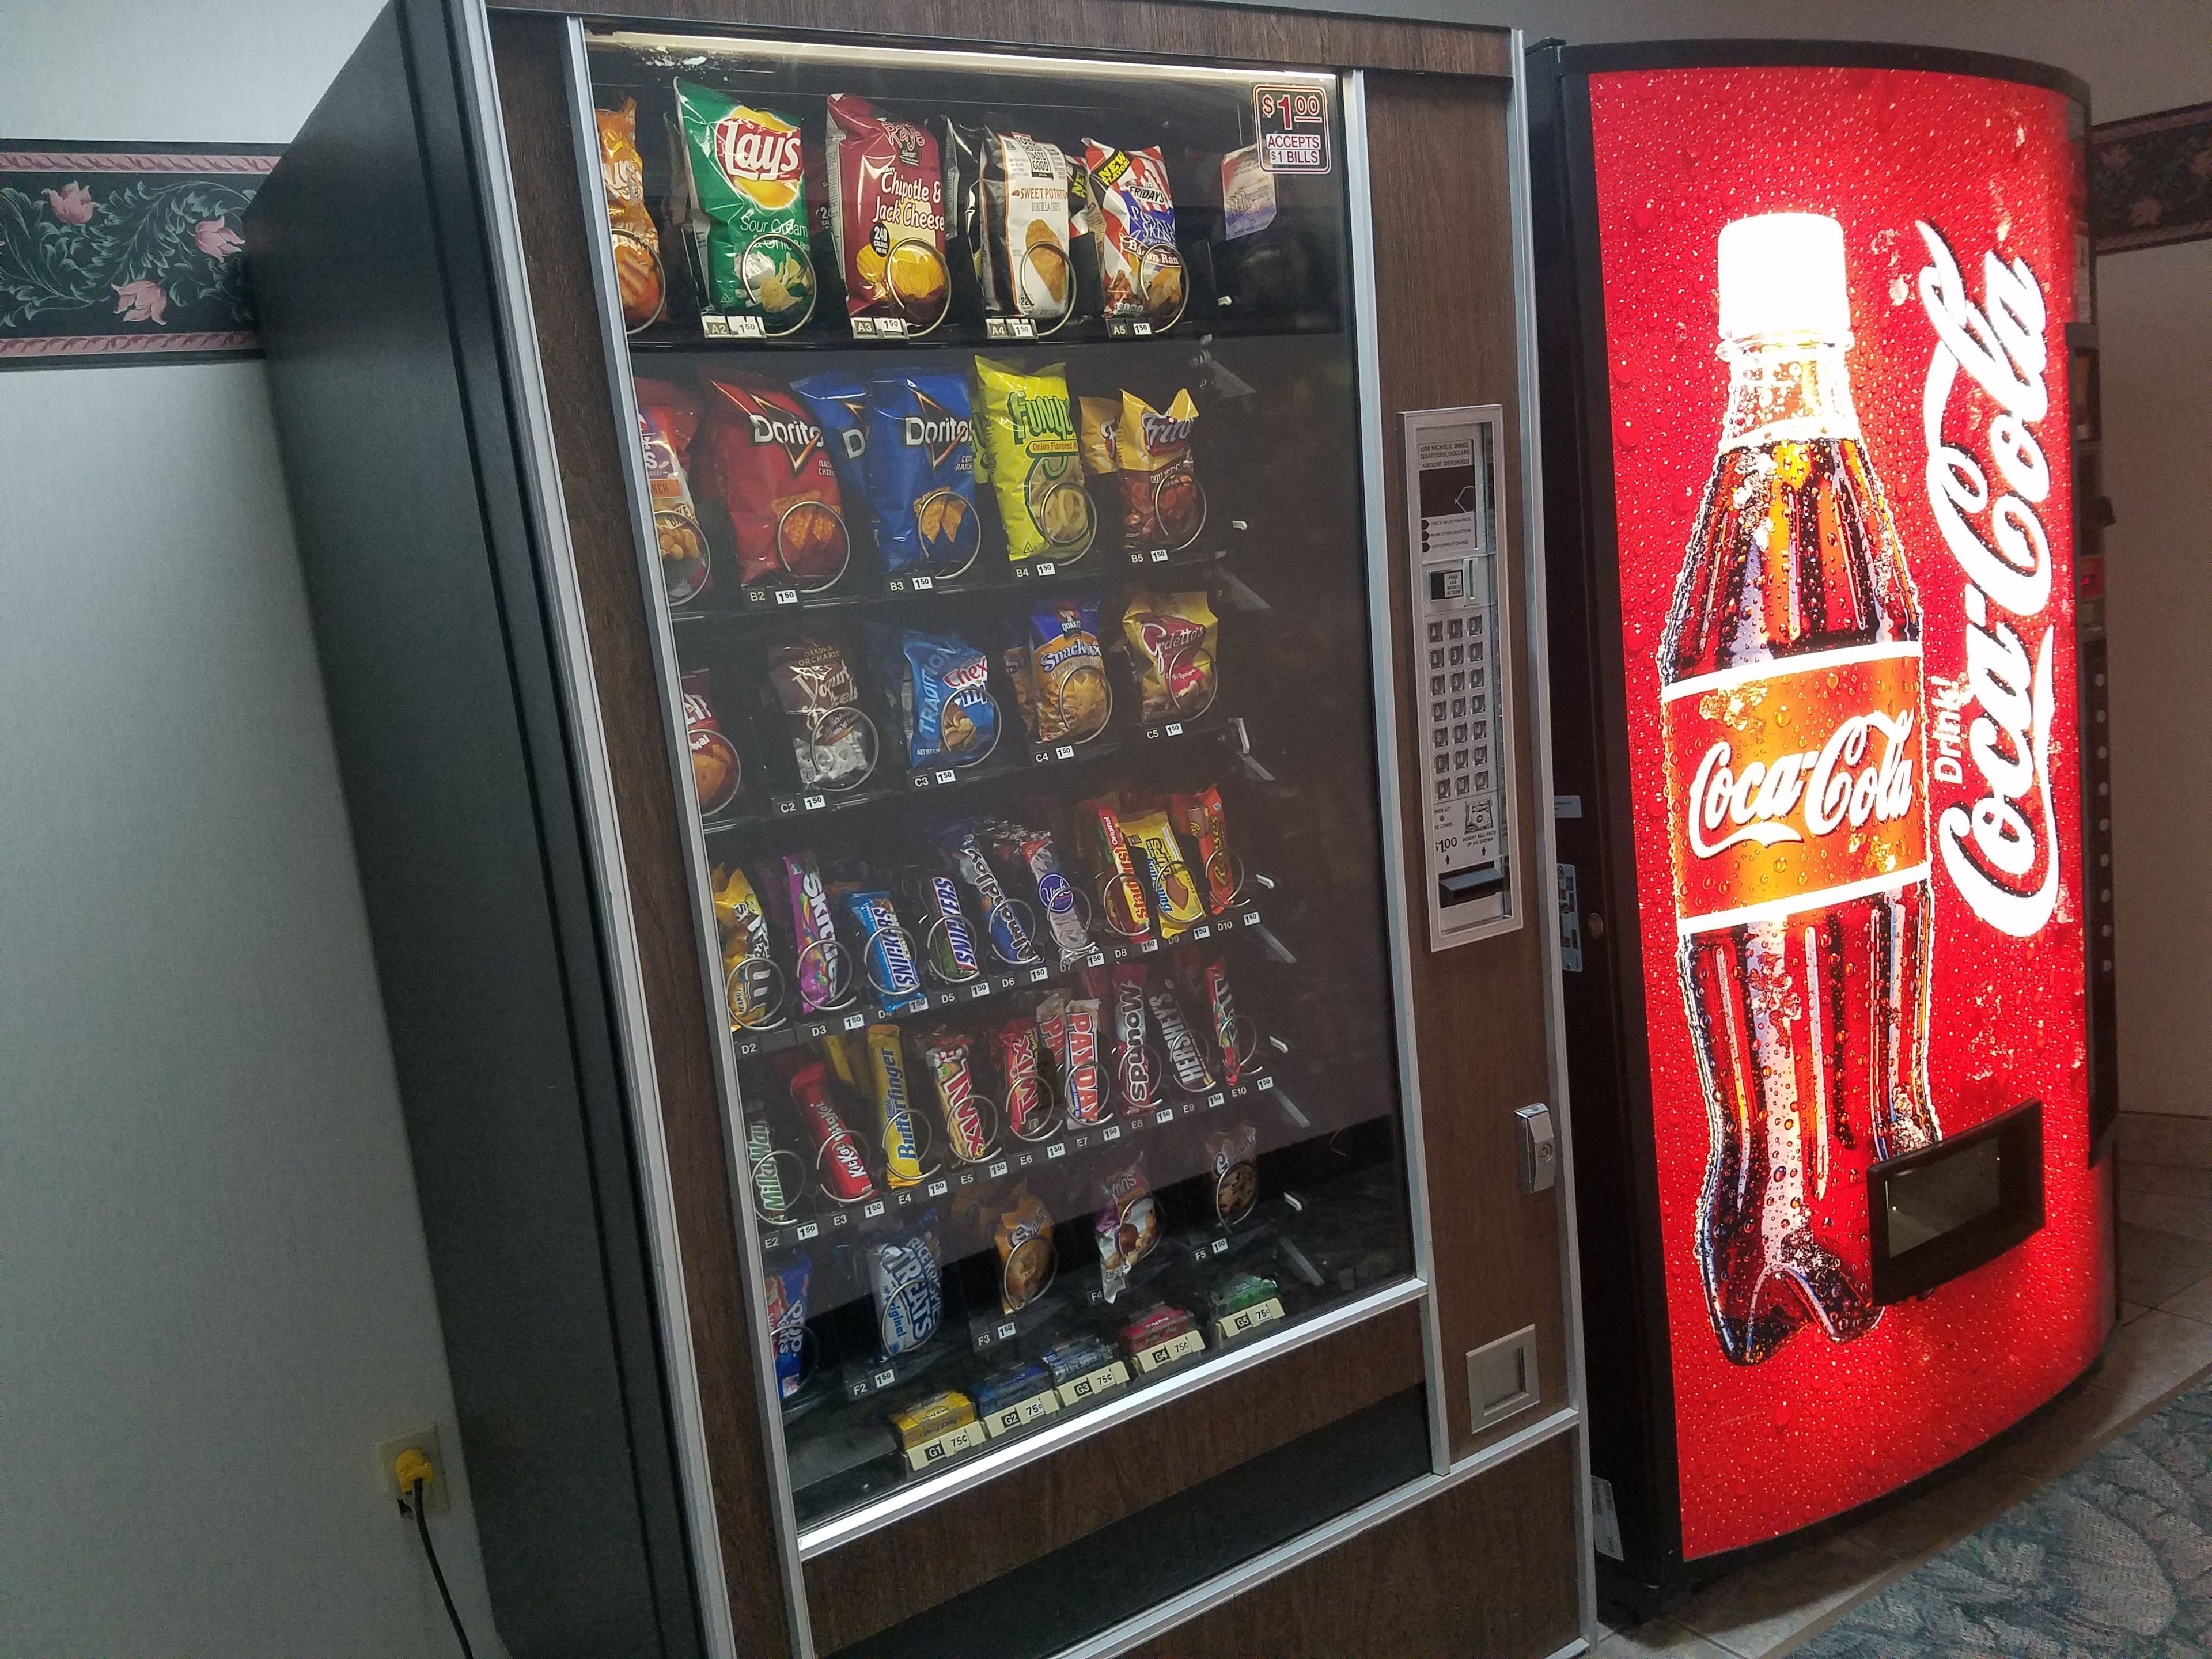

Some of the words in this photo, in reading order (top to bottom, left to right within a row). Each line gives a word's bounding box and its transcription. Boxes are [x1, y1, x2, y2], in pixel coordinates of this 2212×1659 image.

[1267, 135, 1320, 149] ACCEPTS
[724, 121, 801, 182] Lay's
[1271, 151, 1283, 163] $1
[1287, 151, 1319, 164] BILLS
[1032, 160, 1049, 171] GOOD
[1097, 150, 1127, 180] NEW
[1101, 158, 1131, 187] FLAVOR!
[881, 172, 930, 204] Chipotle
[933, 180, 941, 203] &
[1020, 188, 1044, 199] SWEET
[872, 196, 901, 224] Jack
[903, 202, 945, 231] Cheese
[740, 216, 769, 233] Sour
[771, 218, 808, 237] Cream
[874, 226, 888, 242] 240
[710, 323, 728, 334] A2
[857, 321, 873, 332] A3
[991, 326, 1006, 335] A4
[1112, 325, 1126, 335] A5
[750, 415, 824, 448] Dorito
[1032, 442, 1049, 452] Onion
[1050, 441, 1073, 451] Flavored
[1448, 449, 1471, 457] DOLLARS
[1422, 461, 1442, 469] AMOUNT
[1443, 459, 1470, 467] DEPOSITED
[1131, 554, 1144, 563] B5
[1016, 568, 1029, 577] B4
[1915, 219, 2061, 939] Coca-Cola
[889, 582, 905, 591] B3
[749, 591, 766, 601] B2
[1061, 620, 1082, 632] QUAKER
[1039, 639, 1086, 673] Snack
[942, 657, 990, 687] Chex
[1146, 729, 1159, 739] C5
[1931, 673, 1964, 786] Drink!
[1035, 752, 1049, 763] C4
[914, 778, 929, 787] C3
[1688, 706, 1915, 860] Coca-Cola
[780, 803, 797, 813] C2
[1103, 816, 1118, 846] Original
[934, 877, 976, 968] SNICKERS
[1217, 922, 1233, 931] D10
[1168, 935, 1180, 945] D9
[873, 908, 916, 986] SNICKERS
[1115, 949, 1127, 958] D8
[1002, 978, 1016, 988] D6
[941, 993, 956, 1003] D5
[811, 1025, 827, 1036] D3
[1119, 983, 1149, 1102] Mounds
[1149, 993, 1205, 1084] HERSHEY'S
[741, 1044, 757, 1054] D2
[1231, 1086, 1247, 1097] E10
[881, 1046, 918, 1160] Butterfinger
[944, 1058, 986, 1157] TWIX
[1183, 1104, 1195, 1113] E9
[1131, 1120, 1143, 1129] E8
[1077, 1137, 1088, 1147] E7
[1020, 1155, 1033, 1165] E6
[960, 1175, 974, 1184] E5
[898, 1194, 912, 1205] E4
[833, 1215, 847, 1226] E3
[764, 1237, 779, 1248] E2
[906, 1237, 931, 1269] RICE
[1195, 1251, 1206, 1261] F5
[887, 1246, 933, 1340] TREATS
[1091, 1290, 1102, 1302] F4
[1236, 1316, 1249, 1327] G5
[978, 1335, 990, 1346] F3
[1154, 1350, 1168, 1361] G4
[853, 1384, 867, 1395] F2
[1076, 1382, 1090, 1393] G3
[1004, 1414, 1019, 1426] G2
[928, 1446, 943, 1457] G1
